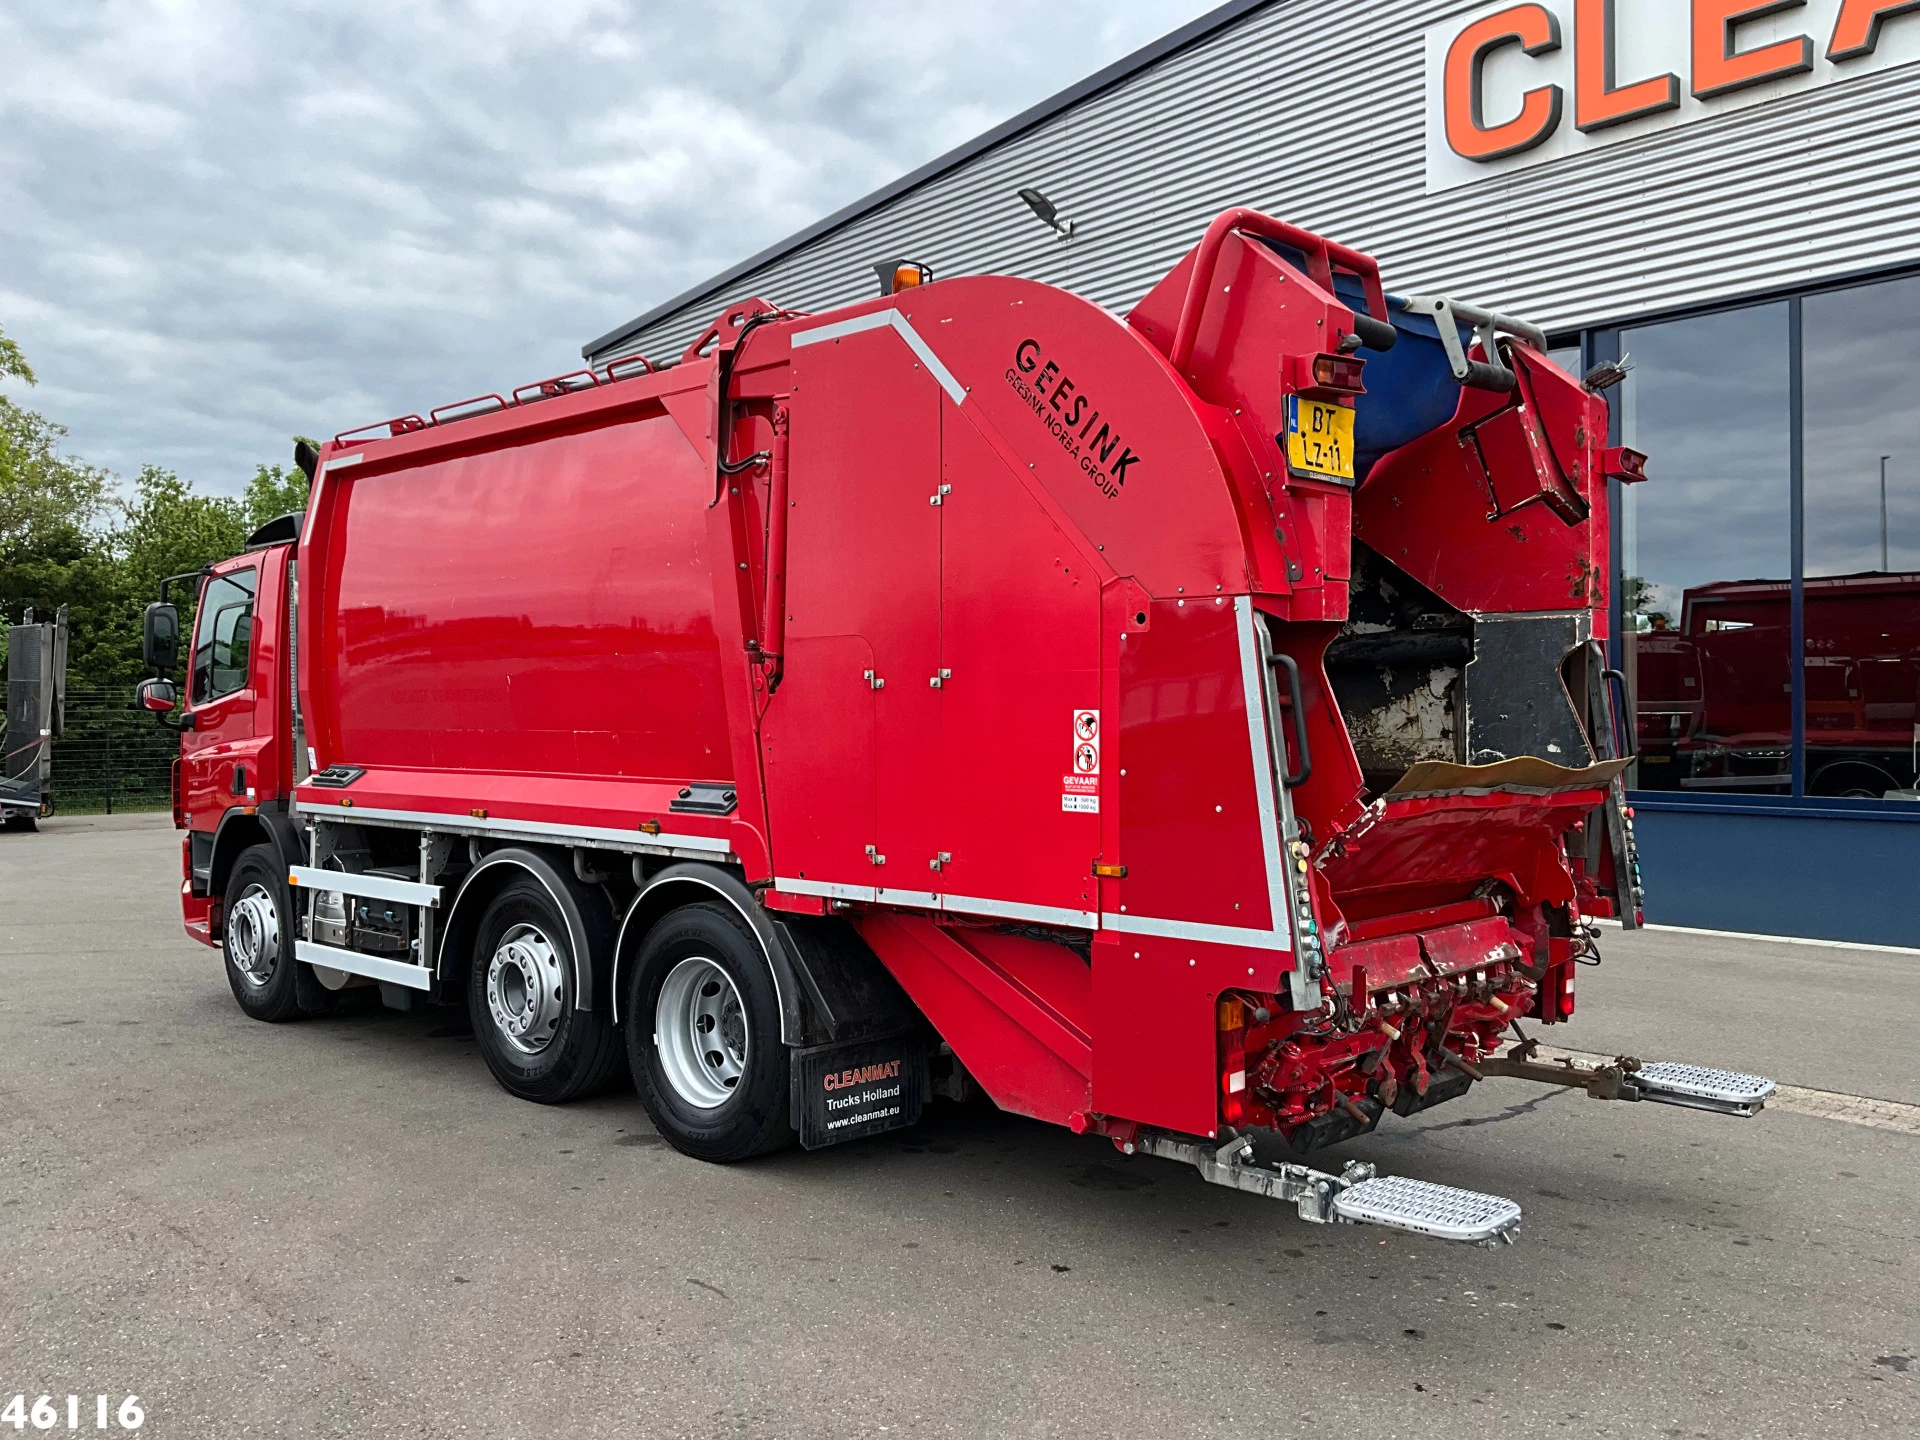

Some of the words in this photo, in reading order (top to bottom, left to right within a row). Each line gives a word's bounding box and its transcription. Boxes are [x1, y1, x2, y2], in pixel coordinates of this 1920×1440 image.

[1016, 339, 1141, 486] GEESINK
[1312, 406, 1336, 435] BT
[1005, 368, 1046, 418] GEESINK
[1043, 413, 1080, 460] NORBA
[1080, 456, 1119, 500] GROUP
[1303, 438, 1341, 472] LZ-11
[1063, 776, 1098, 786] GEVAAR!
[823, 1060, 900, 1092] CLEANMAT
[827, 1094, 860, 1111] Trucks
[863, 1085, 900, 1103] Holland
[827, 1106, 900, 1130] www.cleanmat.eu
